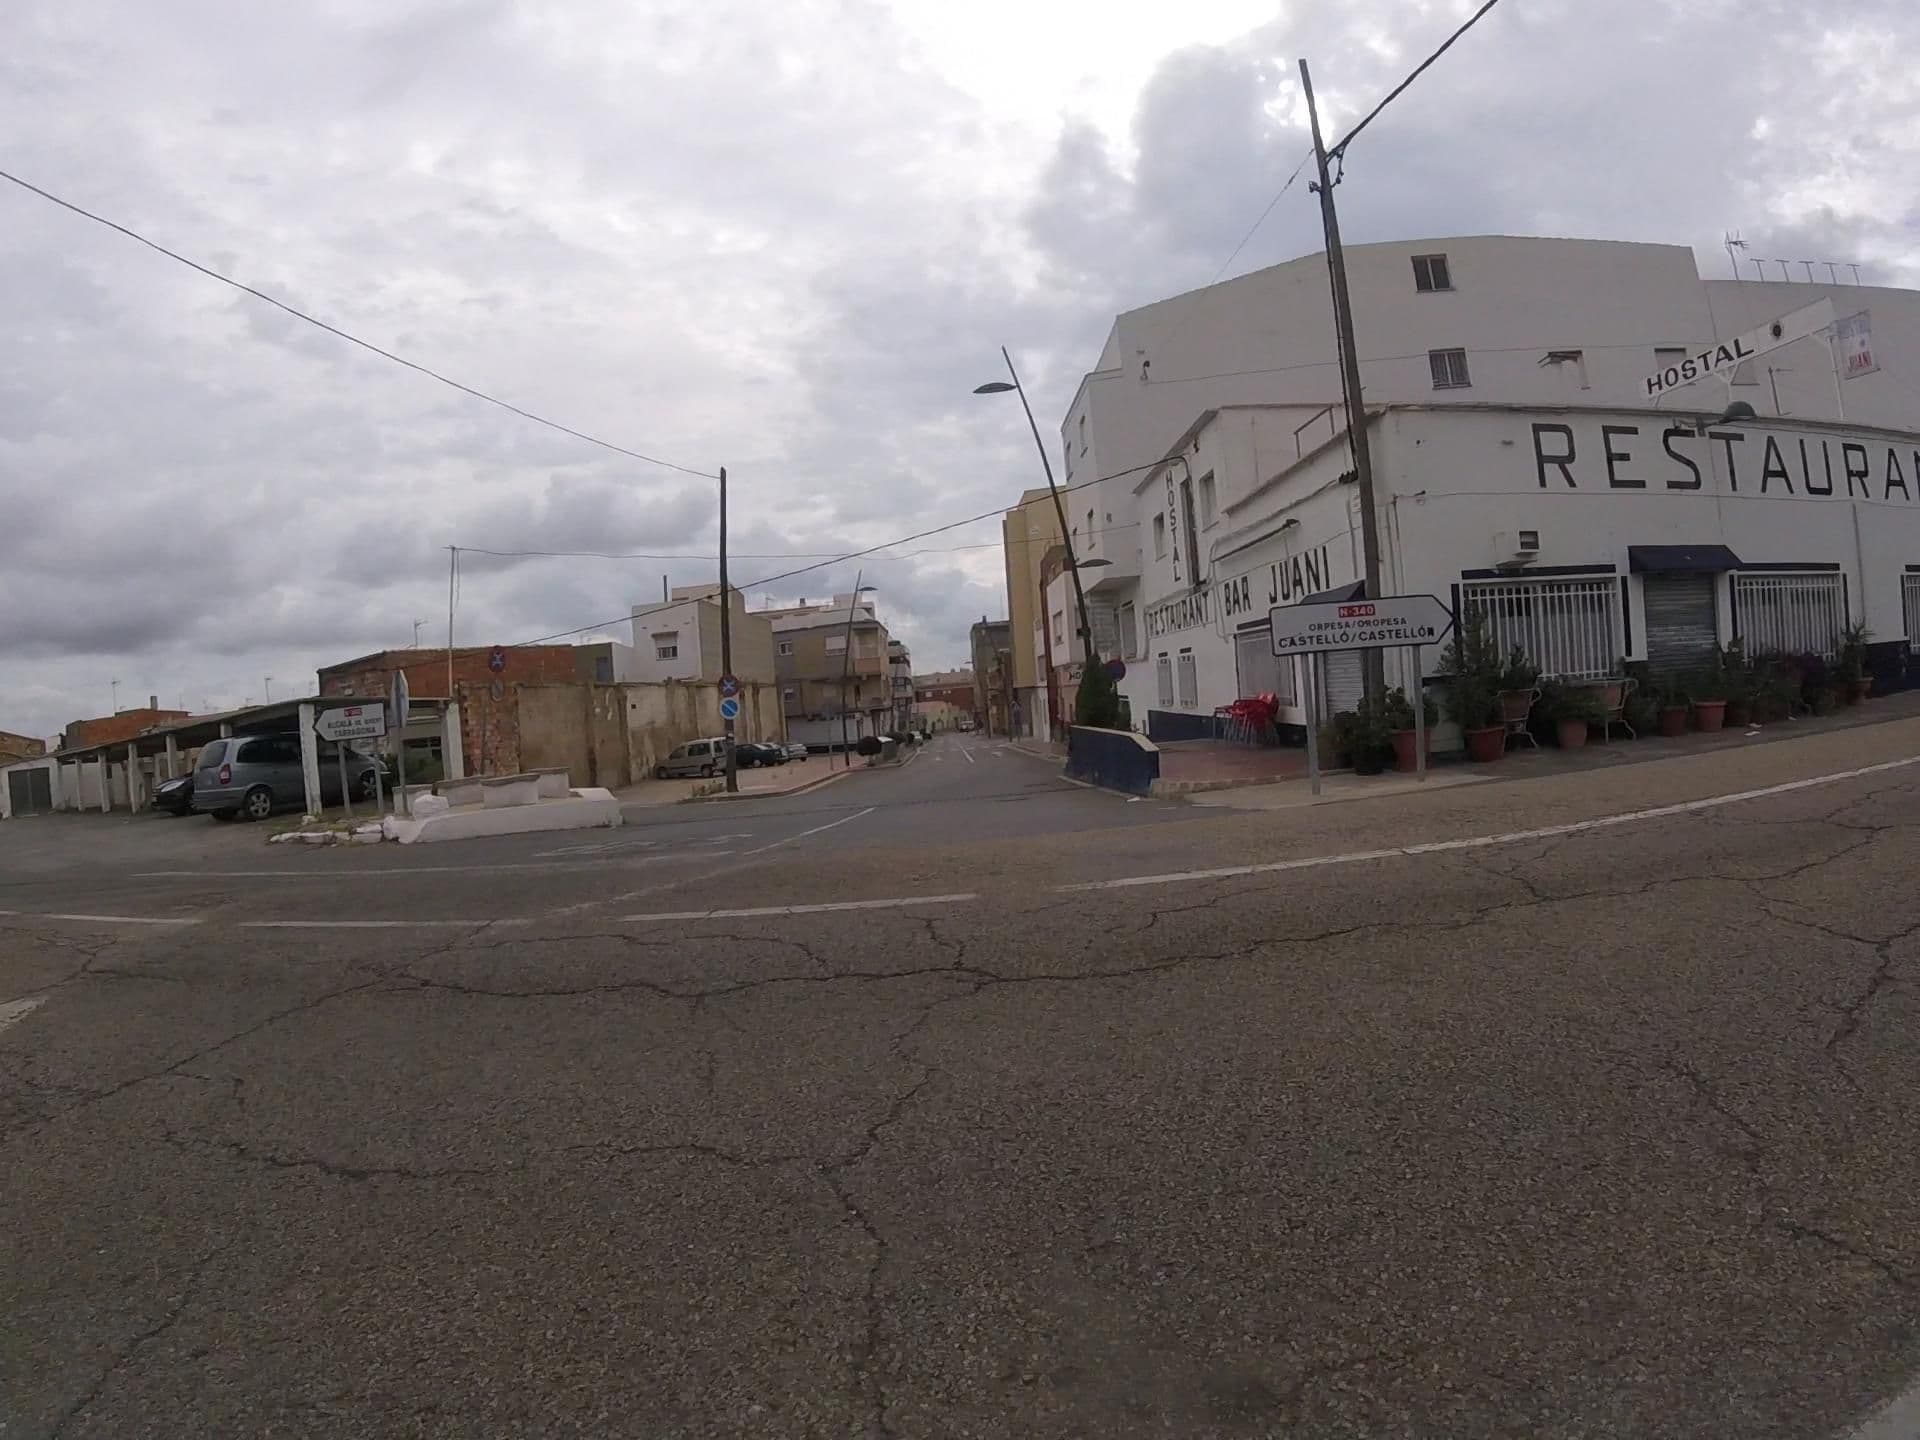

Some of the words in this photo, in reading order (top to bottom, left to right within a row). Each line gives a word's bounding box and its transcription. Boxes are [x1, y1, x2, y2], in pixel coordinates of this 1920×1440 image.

[1646, 338, 1755, 395] HOSTAL
[1531, 422, 1920, 502] RESTAURA
[1166, 469, 1181, 582] HOSTAL
[1224, 575, 1252, 617] BAR
[1268, 545, 1330, 605] JUANI
[1278, 625, 1435, 649] CASTELLÓ/CASTELLÓN
[1308, 617, 1407, 632] ORPESA/OROPESA
[1339, 605, 1375, 618] N-340
